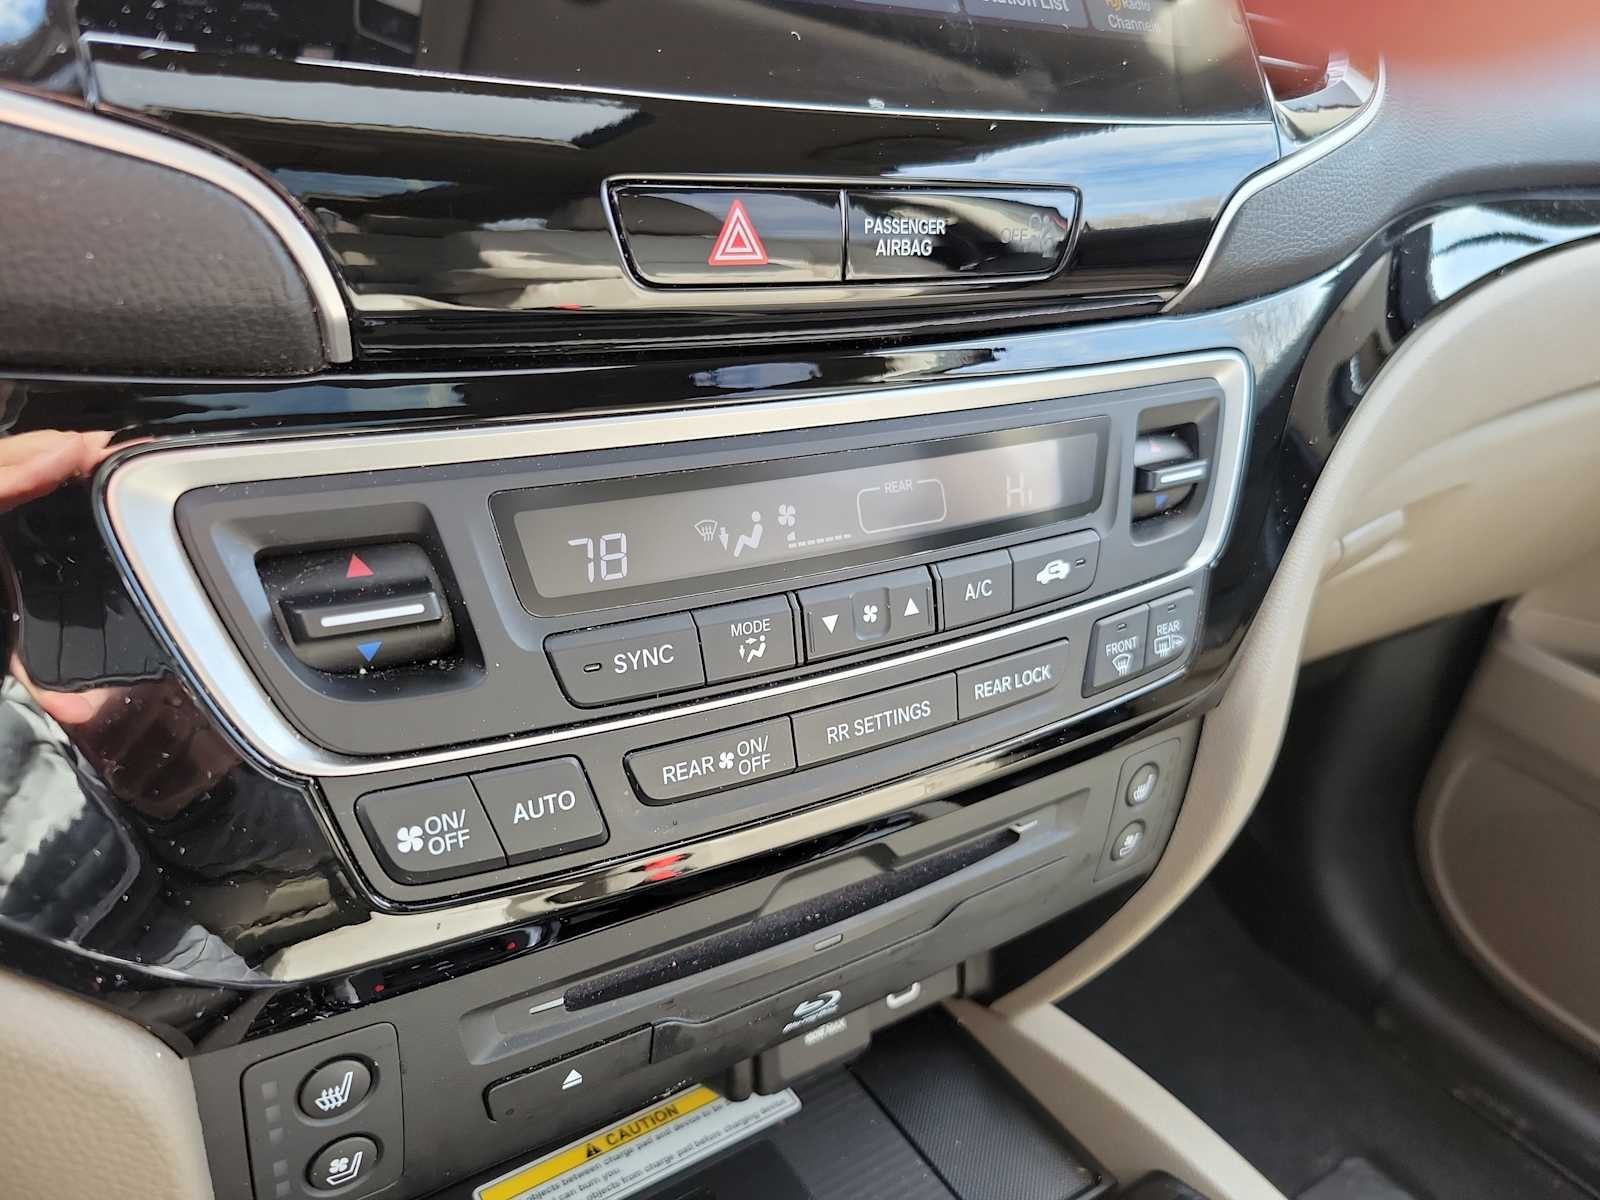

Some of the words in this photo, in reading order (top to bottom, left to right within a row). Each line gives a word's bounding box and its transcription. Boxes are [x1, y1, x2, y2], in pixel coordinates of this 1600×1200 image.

[864, 217, 946, 235] PASSENGER
[875, 239, 933, 257] AIRBAG
[883, 479, 913, 494] REAR
[568, 533, 628, 583] 78
[965, 579, 993, 601] A/C
[730, 618, 771, 637] MODE
[1156, 619, 1180, 636] REAR
[1105, 635, 1137, 656] FRONT
[613, 644, 674, 674] SYNC
[974, 676, 1012, 700] REAR
[1015, 664, 1051, 689] LOCK
[826, 723, 850, 745] RR
[854, 700, 931, 736] SETTINGS
[736, 735, 769, 757] ON/
[662, 755, 716, 785] REAR
[738, 753, 771, 775] OFF
[513, 790, 576, 825] AUTO
[424, 808, 466, 835] ON/
[427, 828, 471, 856] OFF
[605, 1103, 679, 1146] CAUTION
